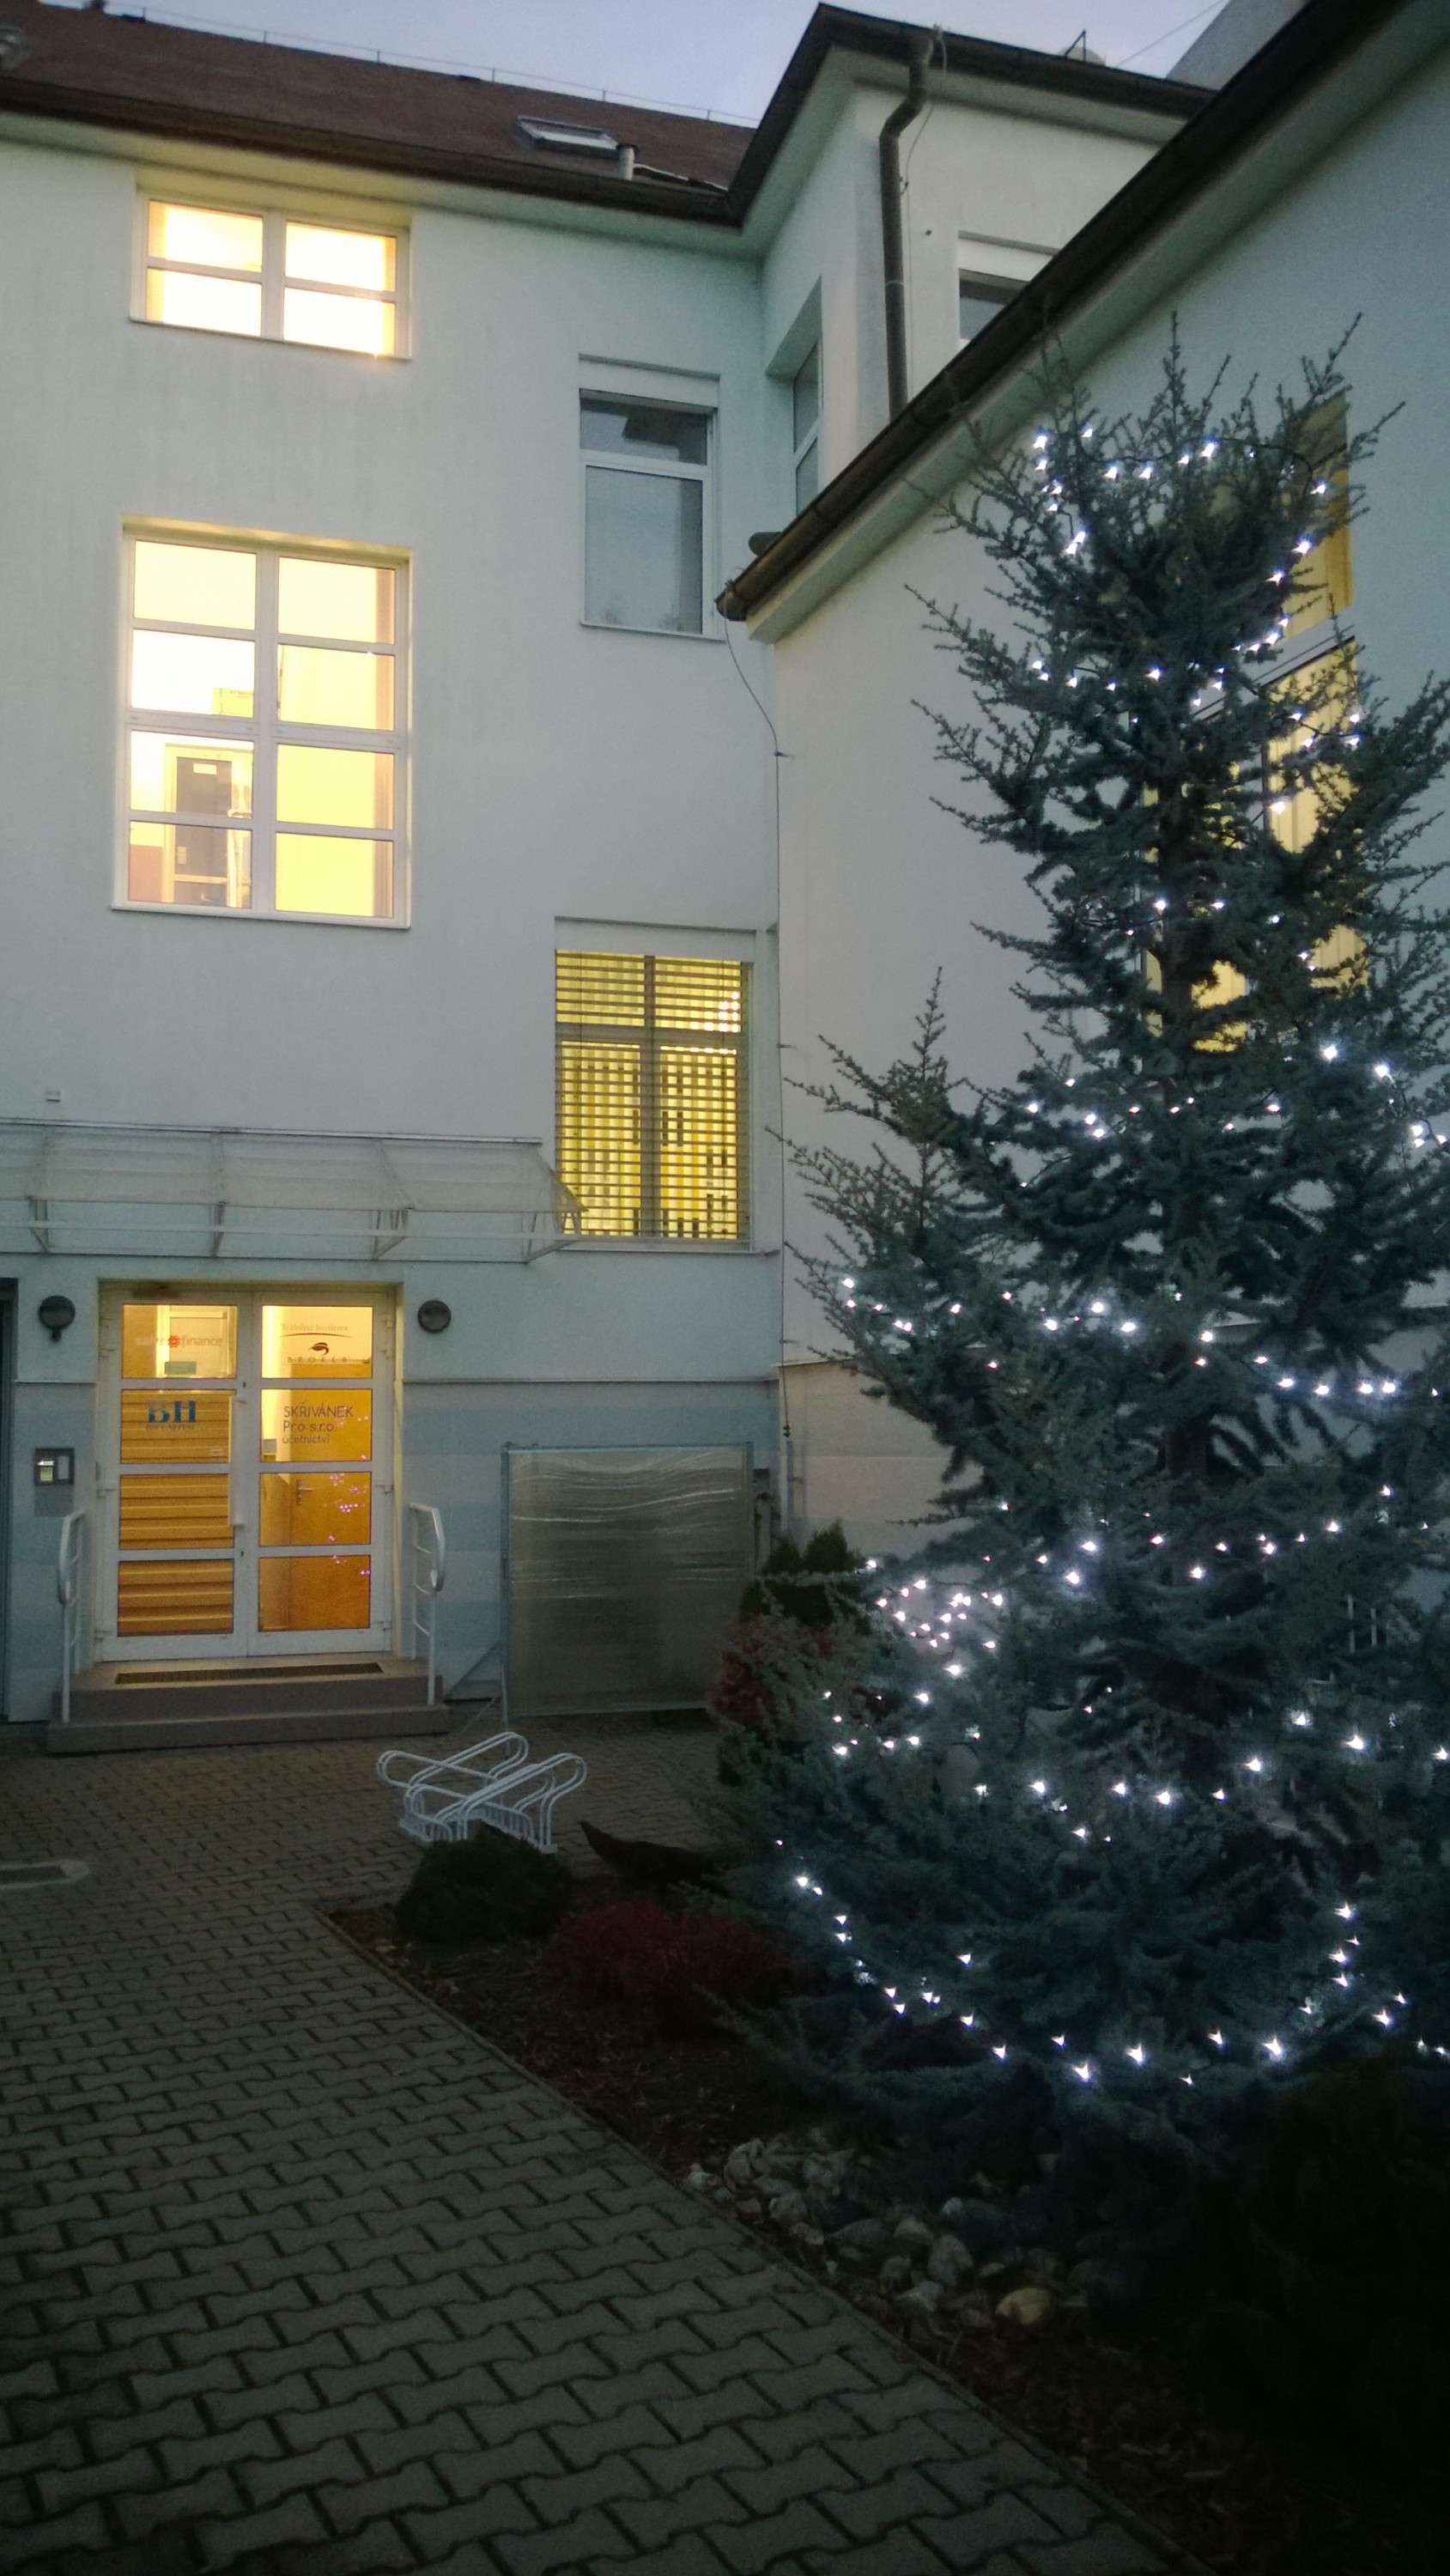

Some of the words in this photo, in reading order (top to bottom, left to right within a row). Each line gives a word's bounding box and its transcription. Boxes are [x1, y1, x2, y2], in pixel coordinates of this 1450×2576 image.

[181, 1335, 223, 1347] finance
[283, 1400, 354, 1418] SKŘIVÁNEK
[283, 1420, 306, 1431] Pro
